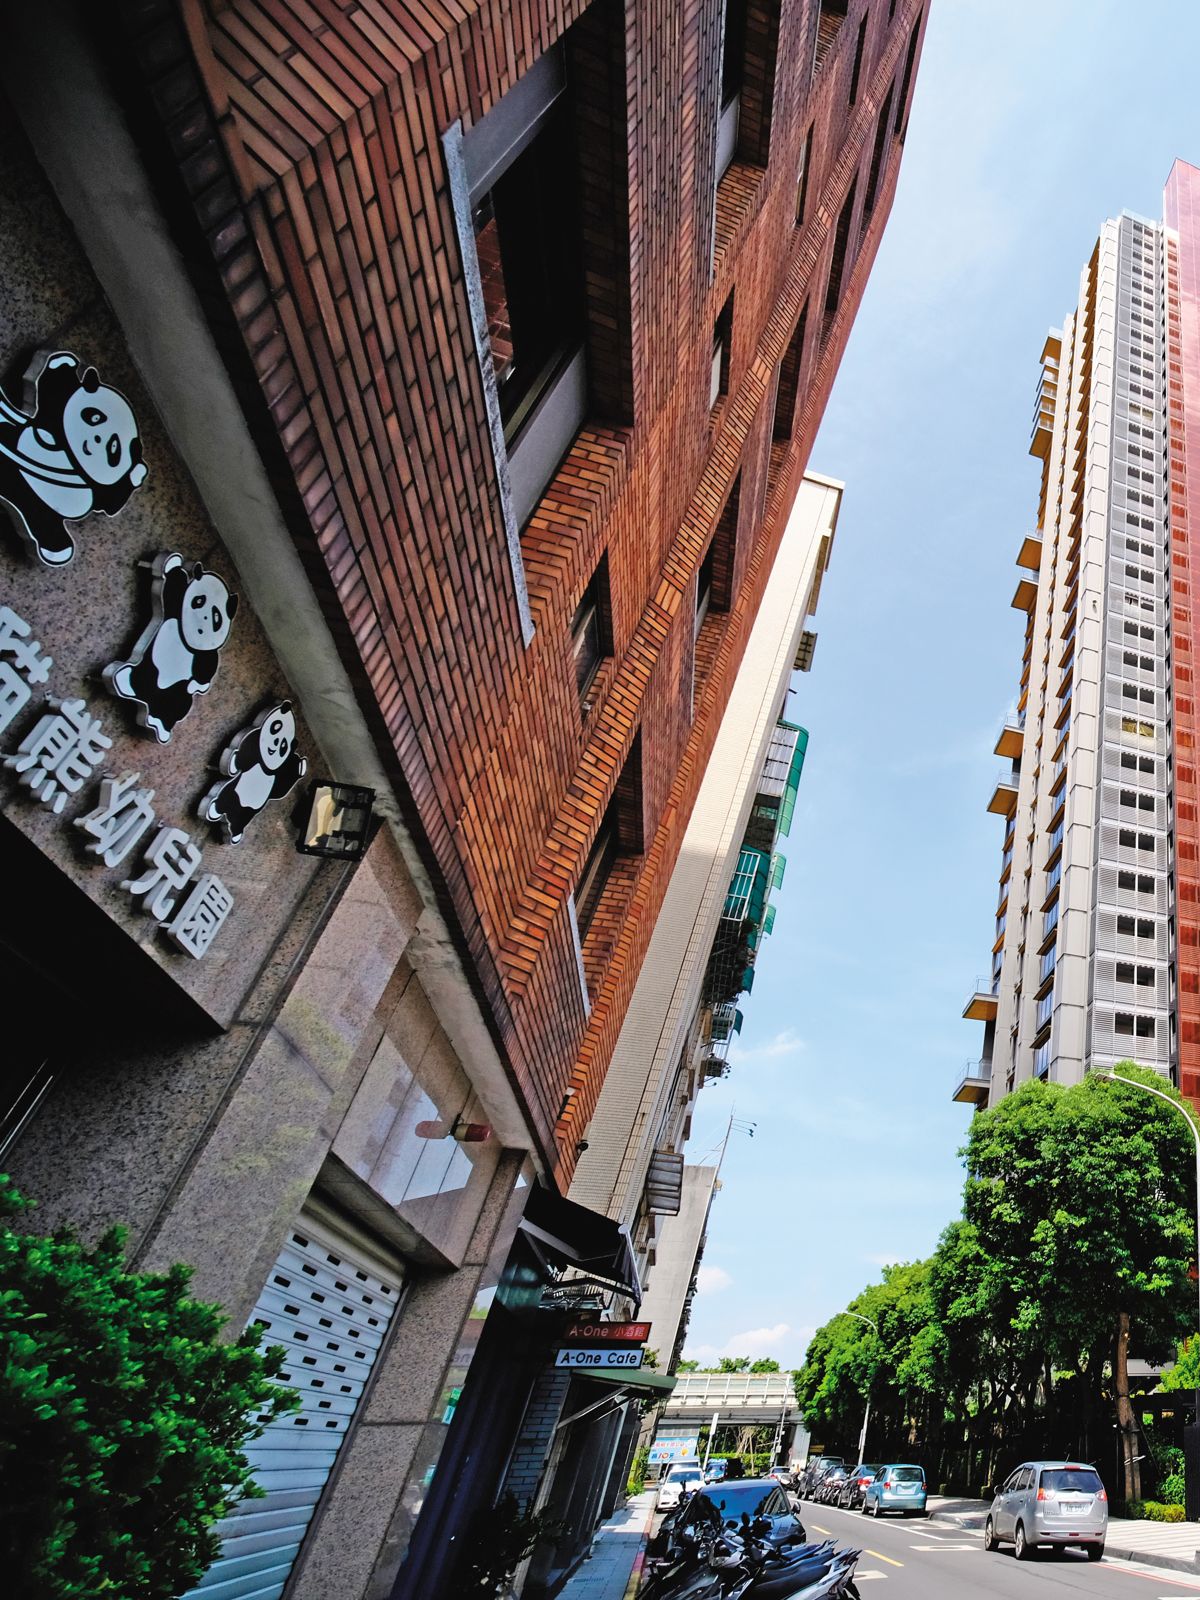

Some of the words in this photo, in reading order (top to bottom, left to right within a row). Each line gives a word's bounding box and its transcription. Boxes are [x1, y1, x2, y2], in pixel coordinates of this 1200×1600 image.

[569, 1325, 609, 1337] A-One
[614, 1325, 646, 1337] 小酒館
[560, 1351, 602, 1364] A-One
[607, 1351, 638, 1364] Cafe
